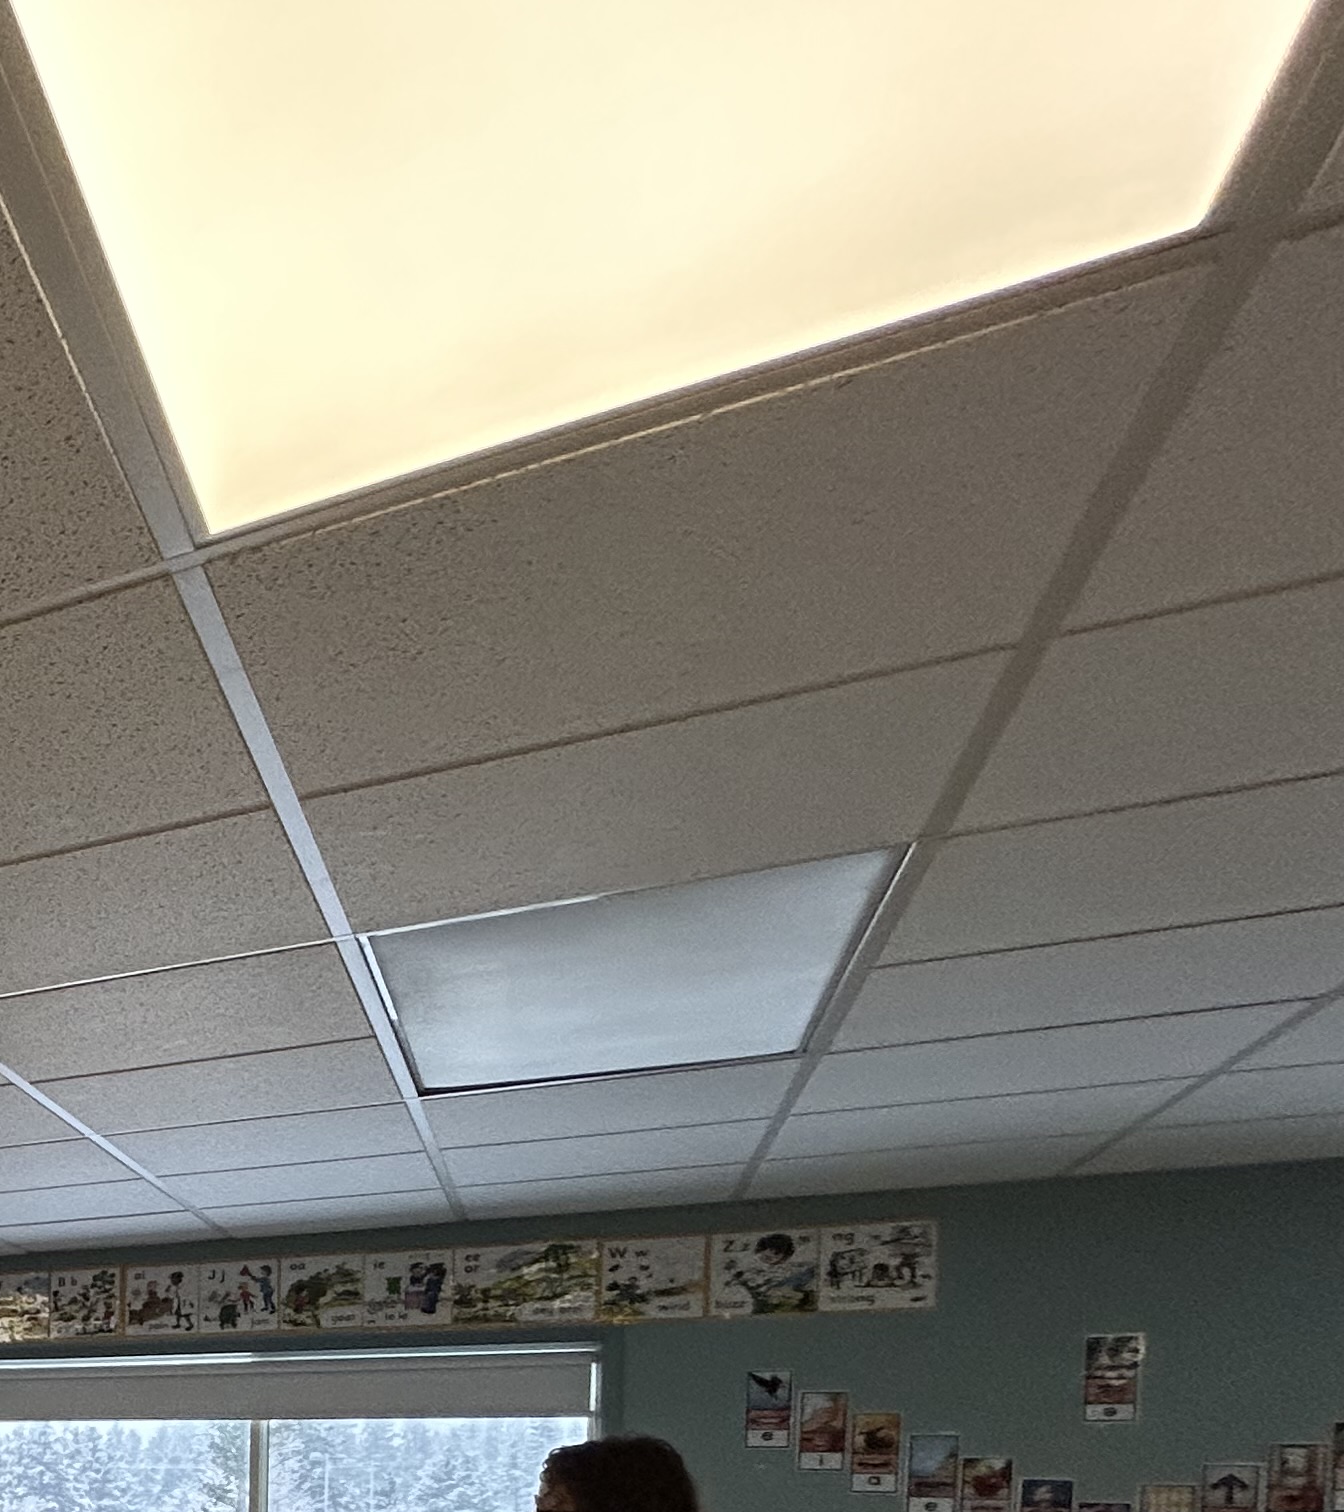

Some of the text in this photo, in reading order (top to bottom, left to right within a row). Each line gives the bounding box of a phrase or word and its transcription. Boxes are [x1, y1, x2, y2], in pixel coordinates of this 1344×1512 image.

[607, 1247, 628, 1258] W
[289, 1262, 306, 1271] oa
[464, 1264, 480, 1273] or
